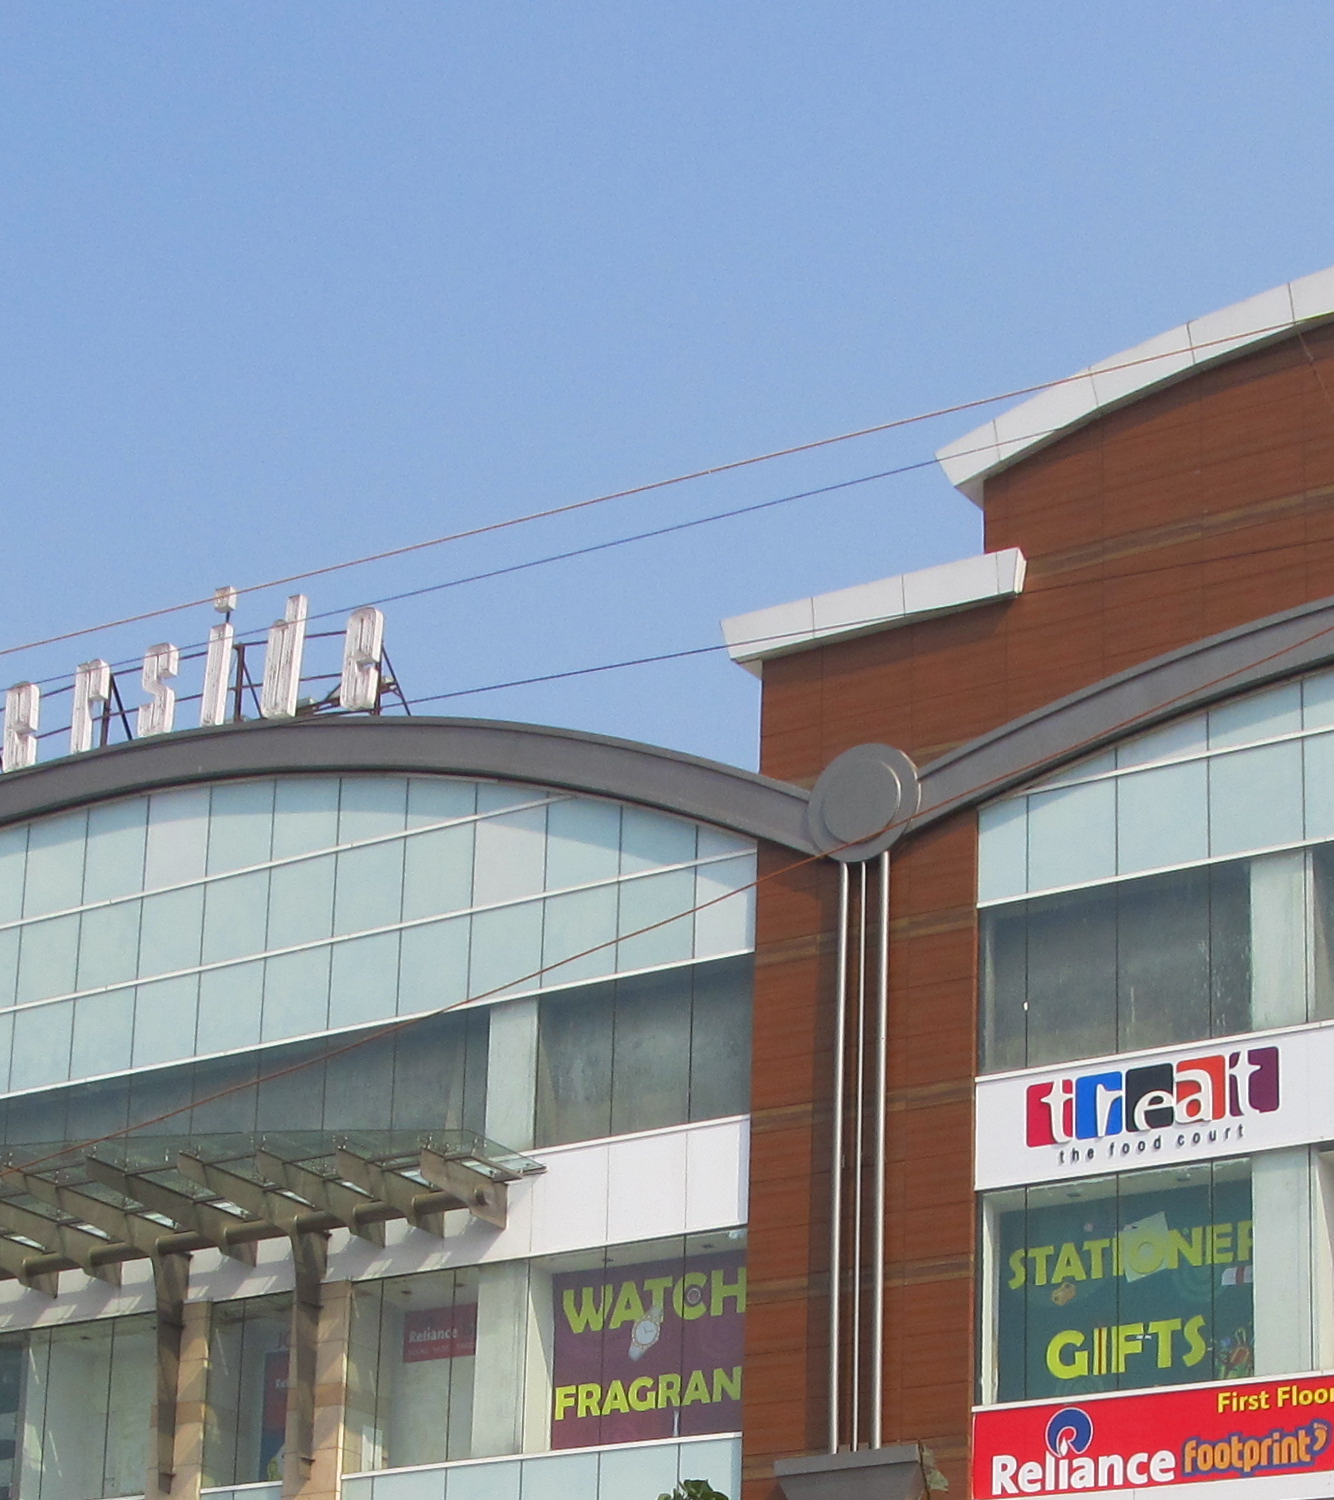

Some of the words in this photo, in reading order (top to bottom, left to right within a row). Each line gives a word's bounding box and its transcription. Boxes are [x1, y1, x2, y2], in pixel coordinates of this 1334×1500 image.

[1031, 1048, 1273, 1146] treat
[1058, 1147, 1095, 1166] the
[1108, 1135, 1162, 1158] food
[1177, 1124, 1245, 1146] court
[1046, 1315, 1207, 1380] GIFTS
[554, 1366, 743, 1422] FRAGRAN
[1217, 1387, 1270, 1414] First
[990, 1440, 1176, 1497] Reliance
[1182, 1424, 1322, 1478] footprint
